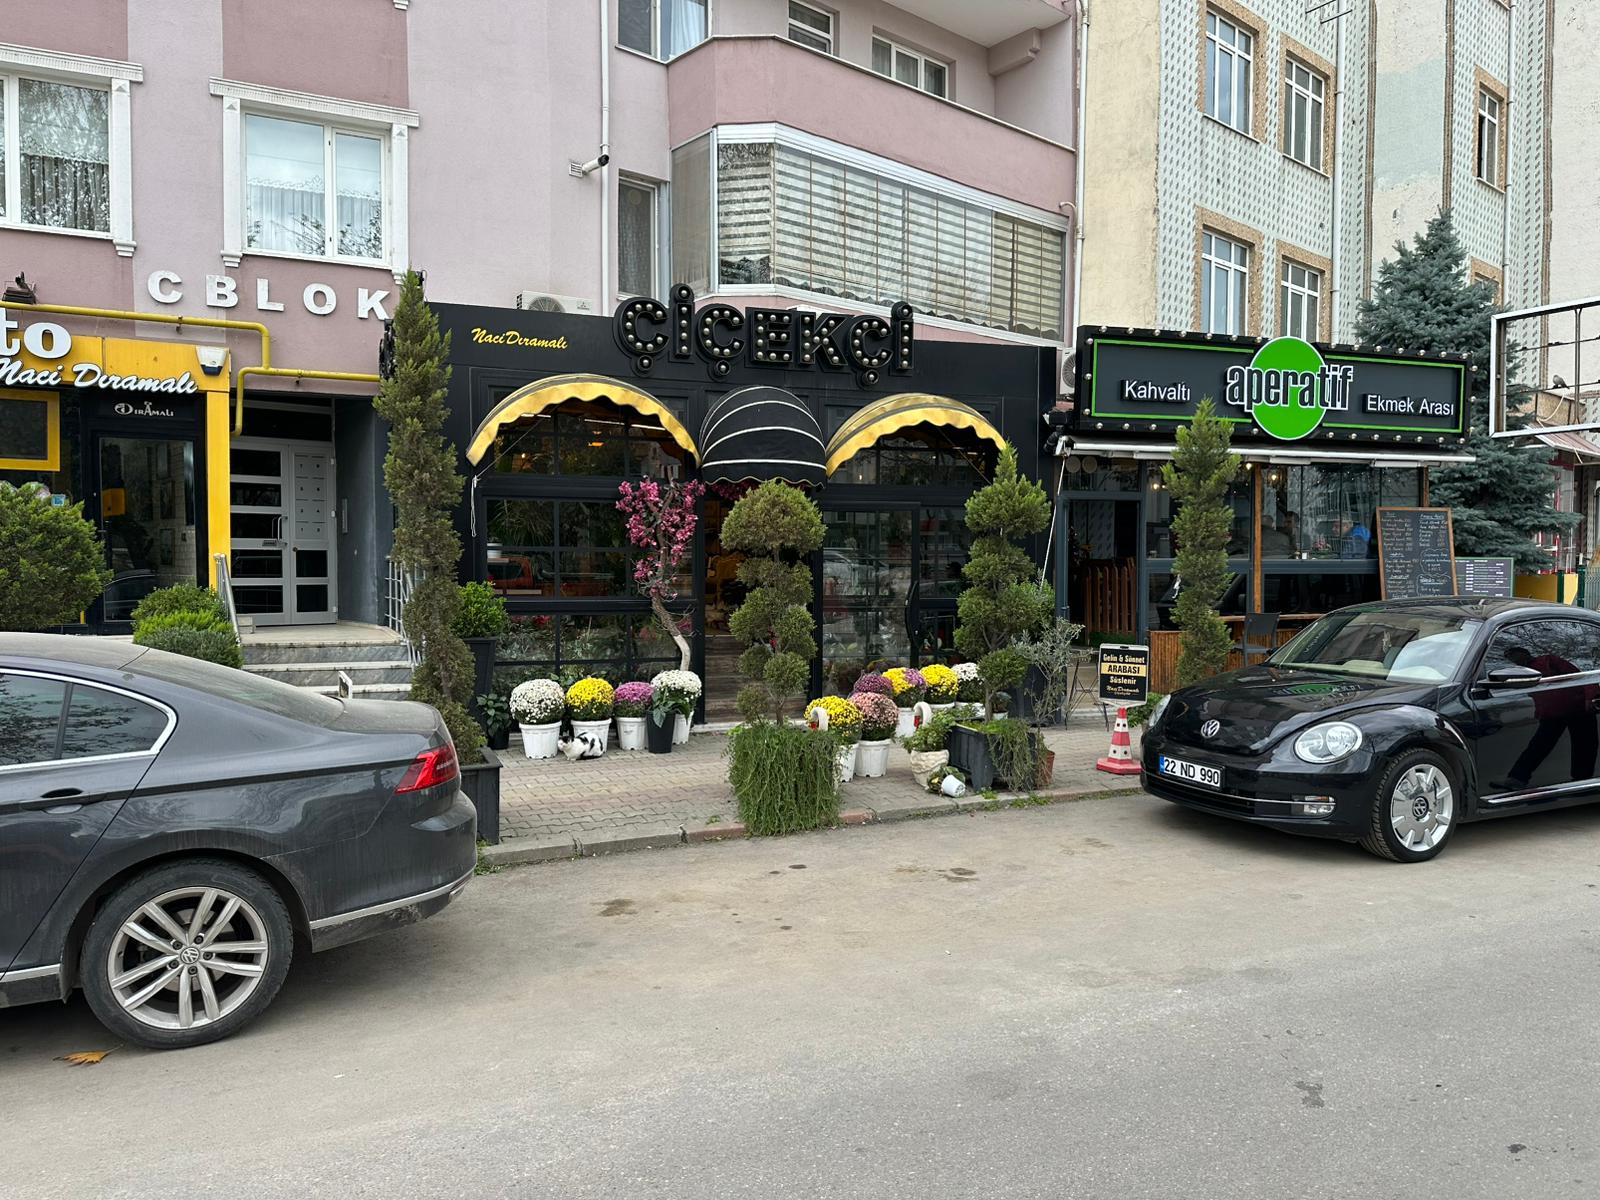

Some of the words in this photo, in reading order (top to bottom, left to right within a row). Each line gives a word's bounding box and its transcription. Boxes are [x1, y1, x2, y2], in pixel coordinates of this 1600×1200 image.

[147, 270, 183, 304] C
[206, 274, 391, 321] BLOK
[471, 327, 505, 344] Naci
[0, 357, 64, 386] Naci
[1124, 379, 1191, 402] Kahvaltı
[1226, 364, 1353, 413] aperatif
[1367, 394, 1414, 414] Ekmek
[1419, 397, 1454, 416] Arası
[1107, 664, 1140, 674] ARABASI
[1118, 654, 1124, 663] &
[1109, 676, 1137, 685] Süslenir
[1164, 759, 1176, 774] 22
[1180, 762, 1195, 779] ND
[1200, 767, 1219, 785] 990
